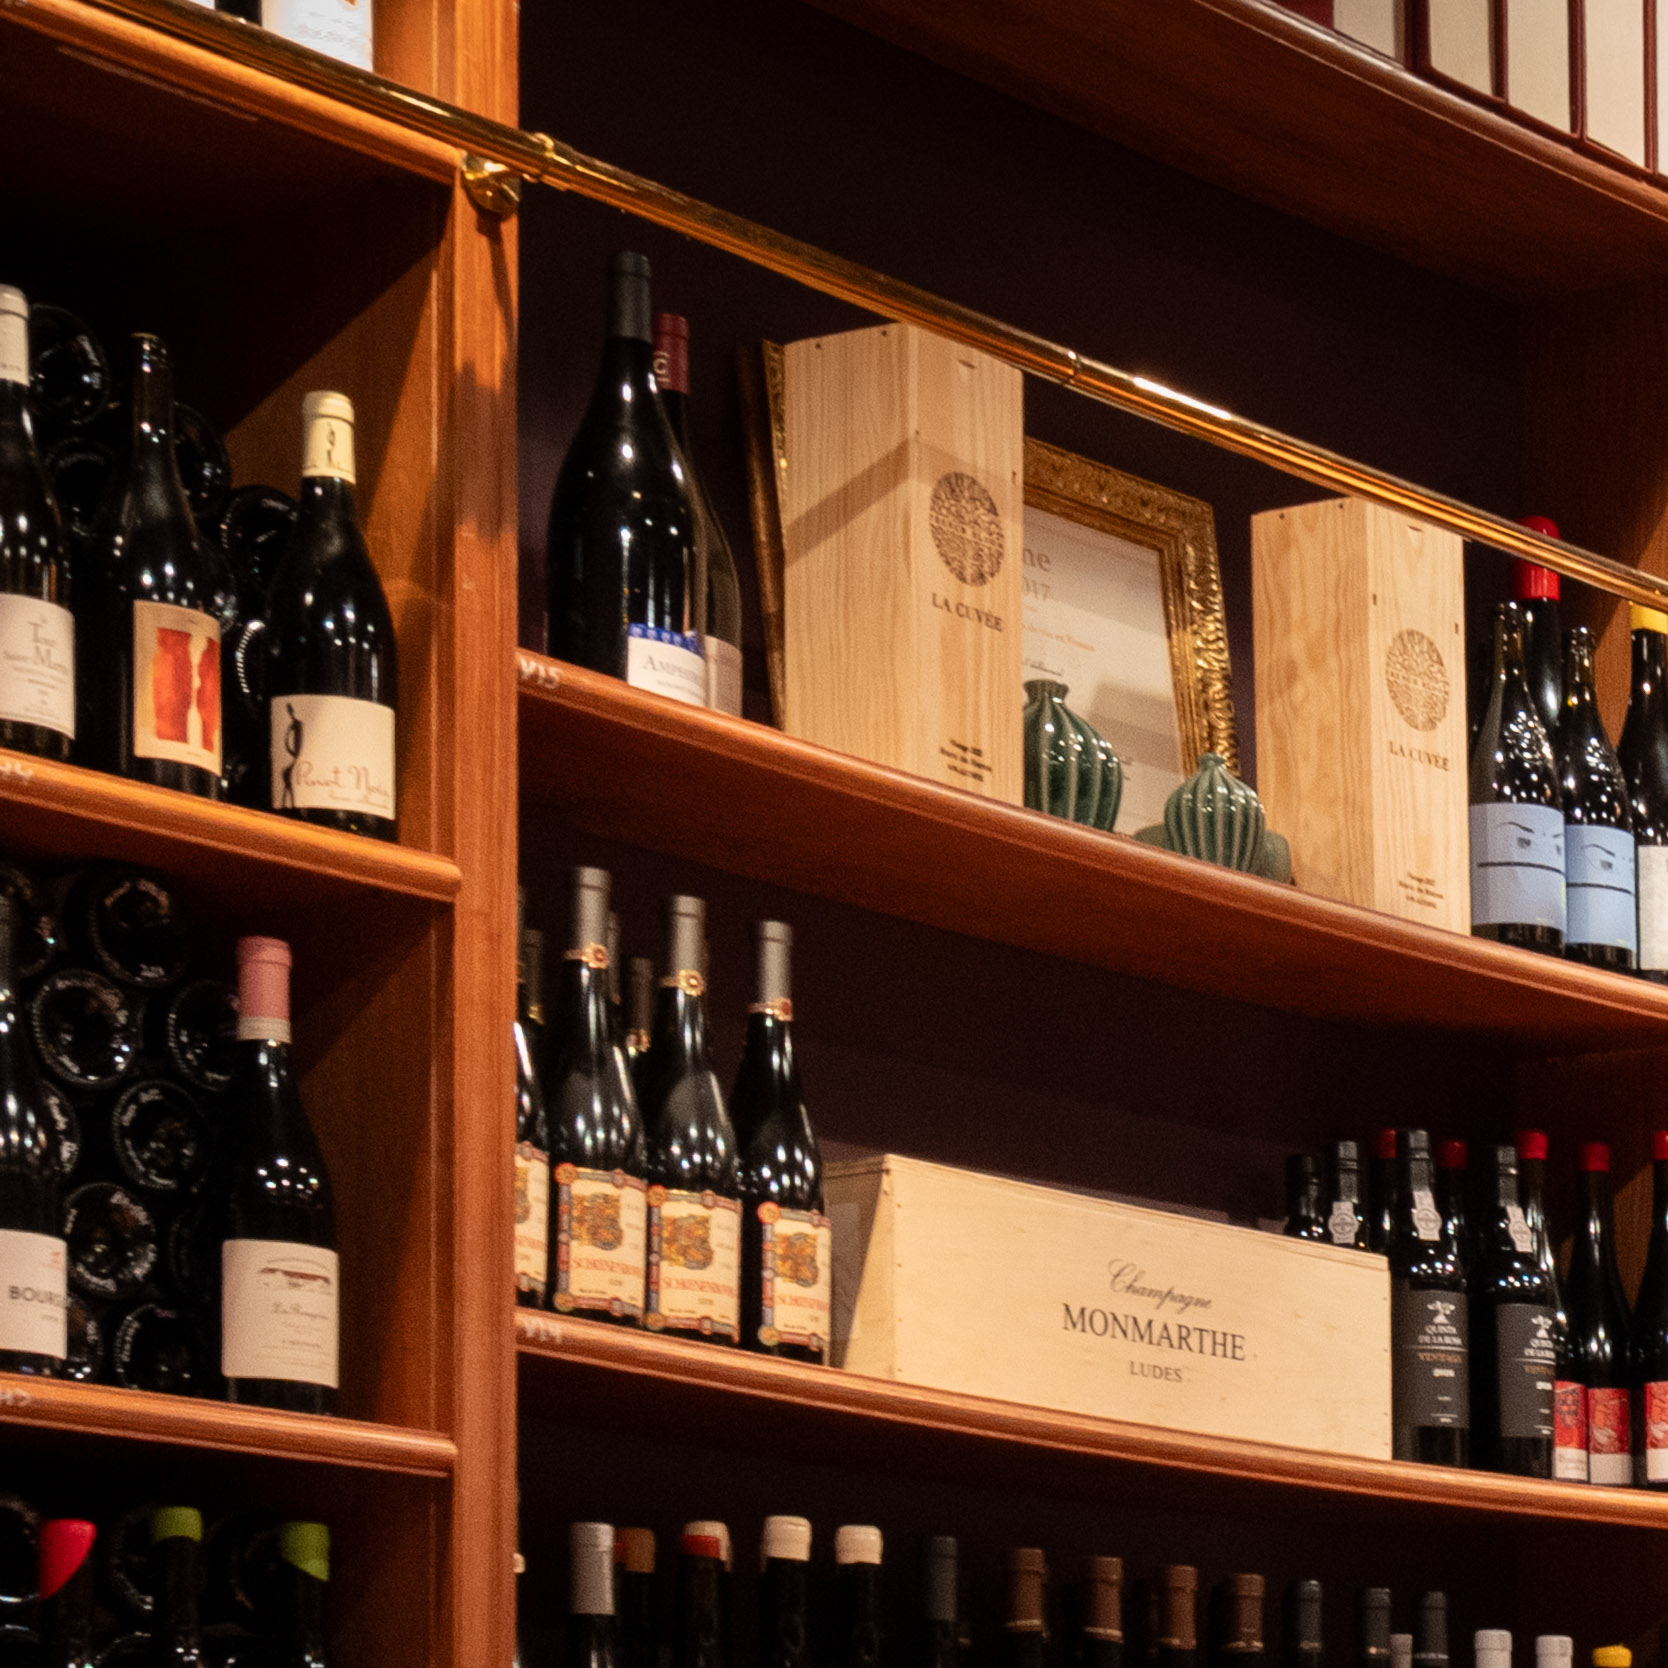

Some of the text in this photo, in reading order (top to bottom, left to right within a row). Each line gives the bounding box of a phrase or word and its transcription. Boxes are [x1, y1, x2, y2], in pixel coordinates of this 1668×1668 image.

[931, 591, 953, 615] LA
[1107, 1256, 1214, 1313] Champagne
[1062, 1302, 1247, 1363] MONMARTHE
[1129, 1360, 1184, 1384] LUDES
